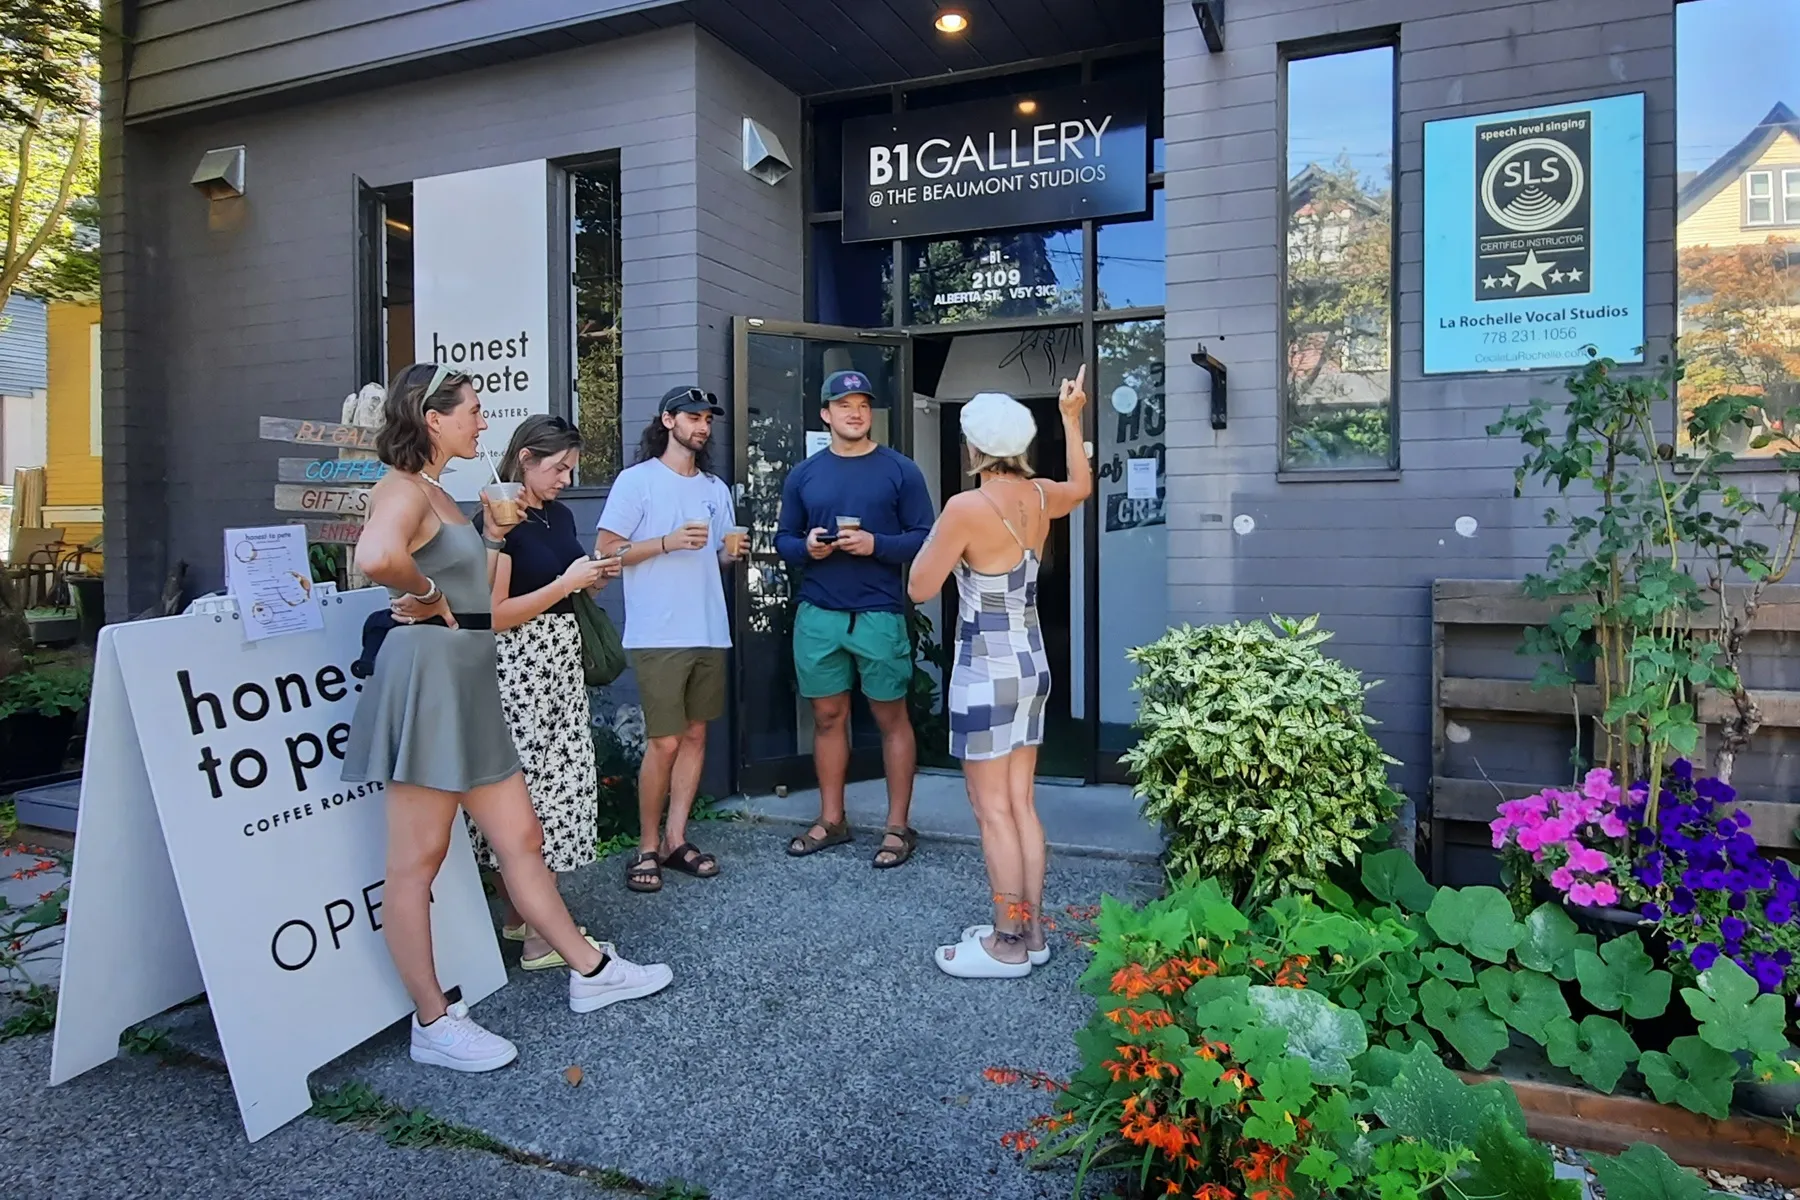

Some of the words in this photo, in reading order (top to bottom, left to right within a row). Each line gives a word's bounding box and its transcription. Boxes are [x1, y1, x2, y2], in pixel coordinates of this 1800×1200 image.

[1481, 127, 1516, 141] speech
[1519, 123, 1543, 135] level
[1546, 119, 1585, 131] singing
[1503, 157, 1560, 187] SLS
[887, 188, 917, 205] THE
[923, 174, 1023, 201] BEAUMONT
[1030, 164, 1106, 189] STUDIOS
[1480, 240, 1524, 251] CERTIFIED
[1526, 234, 1583, 247] INSTRUCTOR
[972, 269, 1020, 289] 2109
[934, 291, 981, 305] ALBERTA
[1009, 286, 1033, 299] V5Y
[1035, 284, 1057, 297] 3K3
[1440, 317, 1455, 329] La
[1460, 312, 1522, 328] Rochelle
[1525, 308, 1565, 323] Vocal
[1570, 304, 1628, 320] Studios
[433, 331, 528, 363] honest
[1483, 327, 1576, 345] 778.231.1056
[482, 407, 528, 418] OASTERS
[305, 461, 389, 480] COFFEE
[198, 746, 267, 798] to
[285, 722, 351, 791] pe
[243, 803, 313, 836] COFFEE
[321, 781, 385, 810] ROASTE
[271, 879, 434, 971] OPE
